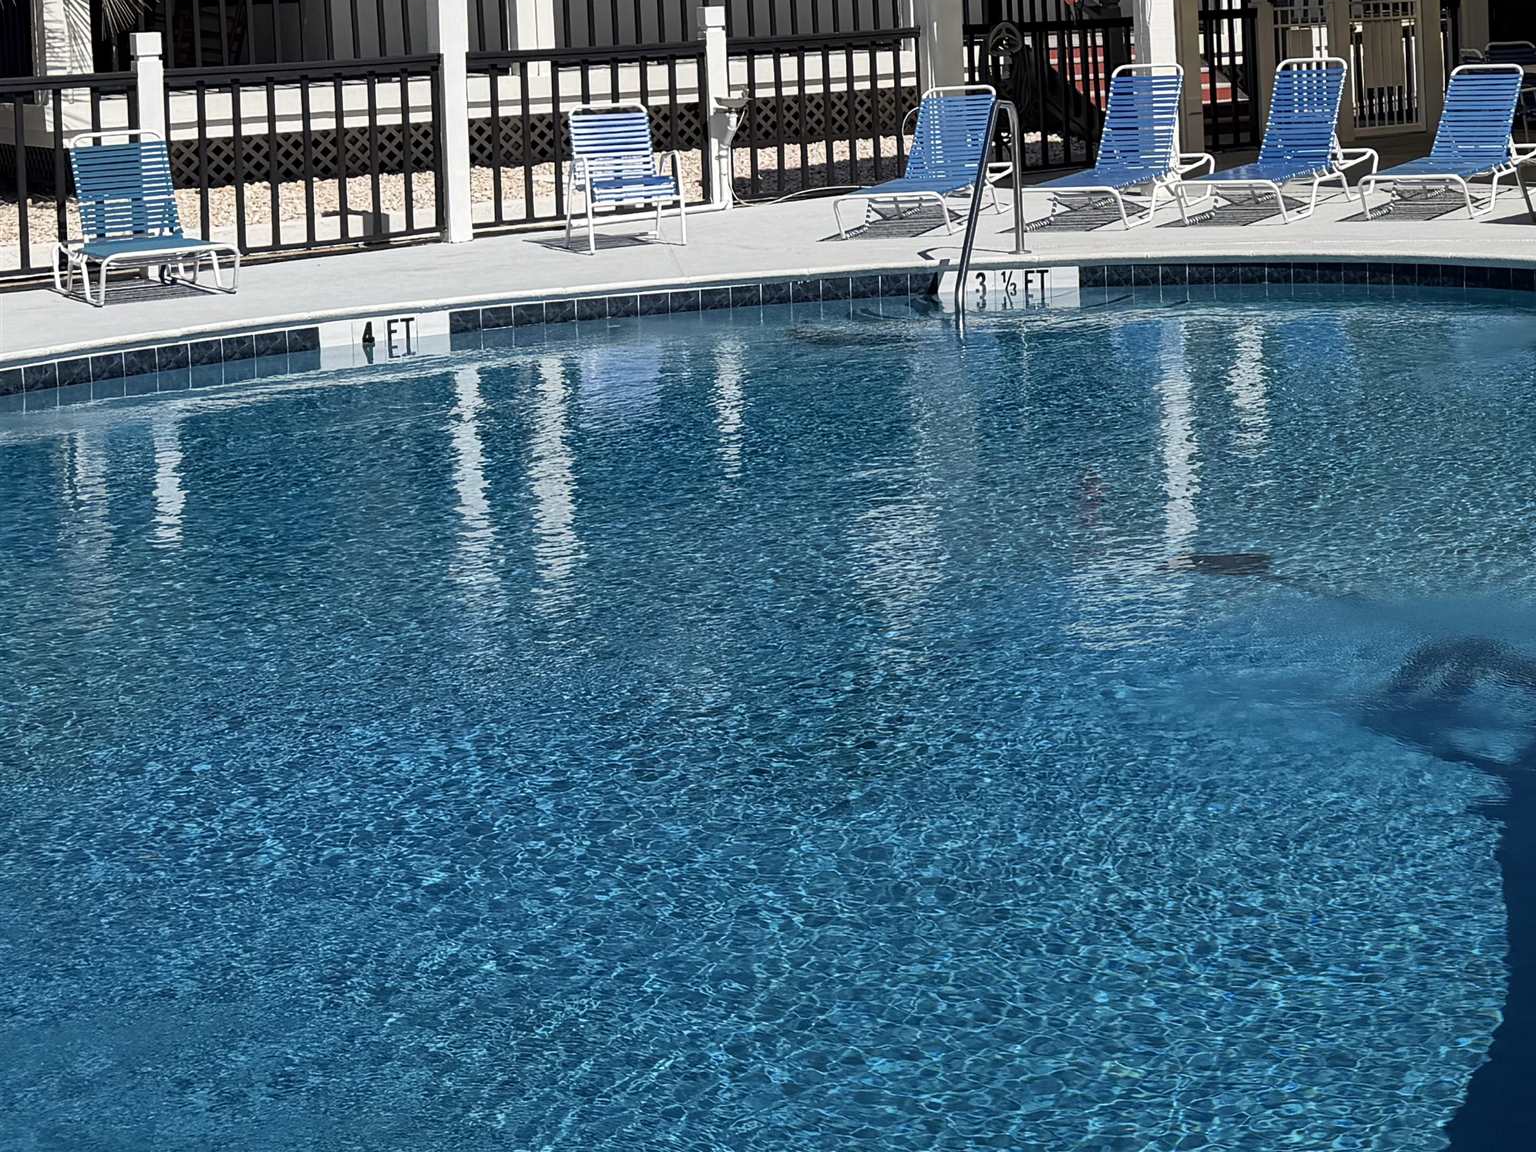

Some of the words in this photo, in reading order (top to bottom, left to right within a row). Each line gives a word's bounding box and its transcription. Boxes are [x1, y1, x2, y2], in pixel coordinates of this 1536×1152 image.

[975, 272, 987, 296] 3
[1025, 269, 1049, 294] FT
[362, 321, 375, 346] 4
[387, 317, 415, 342] FT
